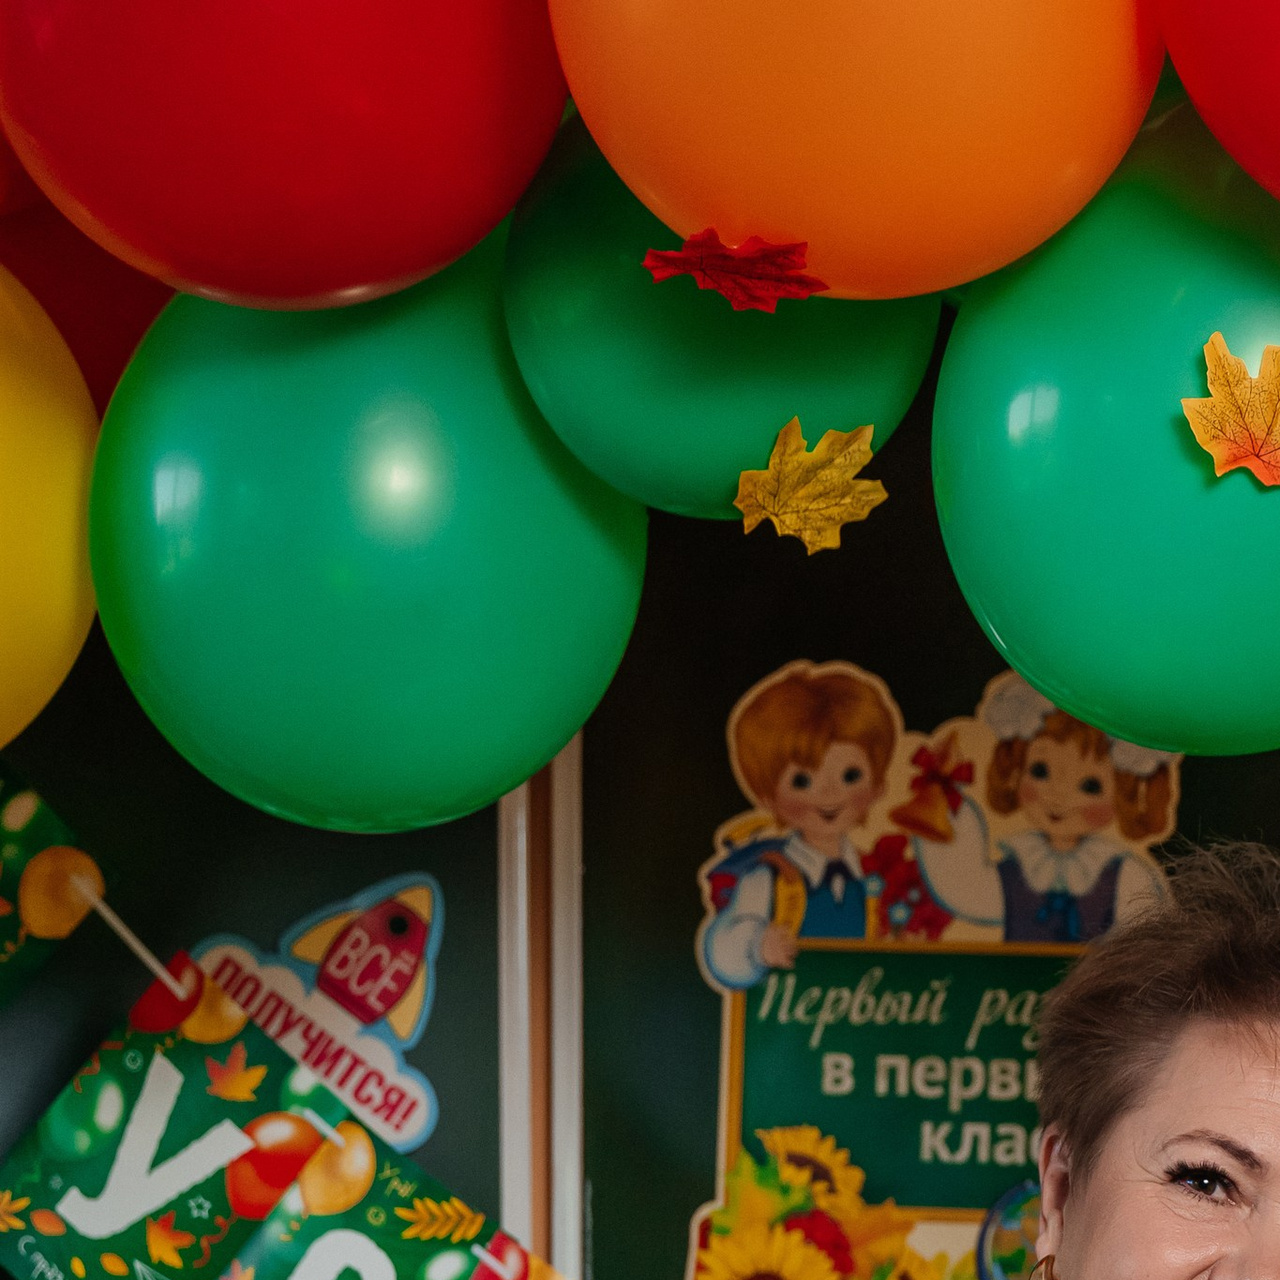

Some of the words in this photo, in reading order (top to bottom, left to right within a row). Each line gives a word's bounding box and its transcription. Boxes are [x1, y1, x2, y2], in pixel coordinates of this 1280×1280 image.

[212, 957, 418, 1131] ПОЛУЧИТСЯ!
[758, 966, 951, 1050] Первый
[821, 1052, 855, 1096] в
[875, 1054, 1041, 1114] перв
[919, 1120, 1041, 1166] кла
